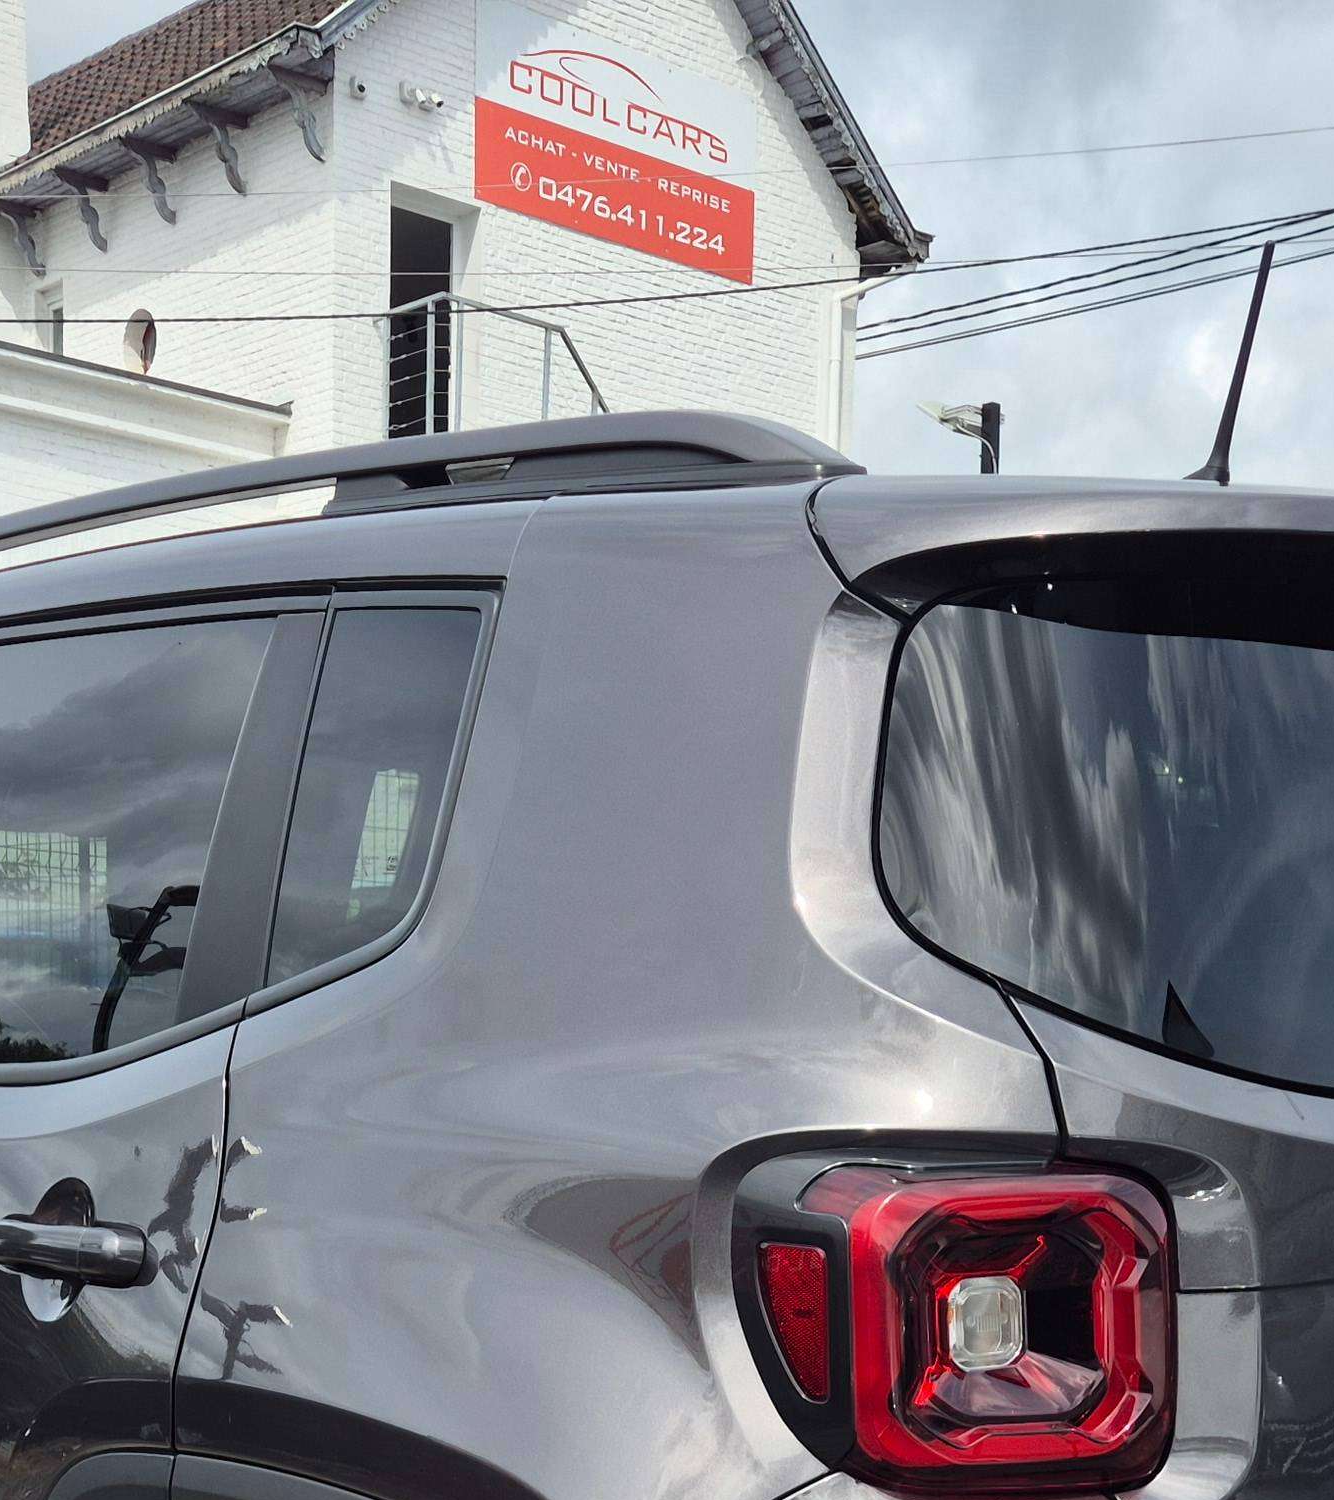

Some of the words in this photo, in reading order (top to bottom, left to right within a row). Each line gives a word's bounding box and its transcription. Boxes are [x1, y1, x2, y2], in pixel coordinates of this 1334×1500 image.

[504, 126, 566, 157] ACHAT
[583, 151, 641, 183] VENTE
[657, 178, 731, 214] REPRISE
[538, 176, 725, 255] 0476.411.224
